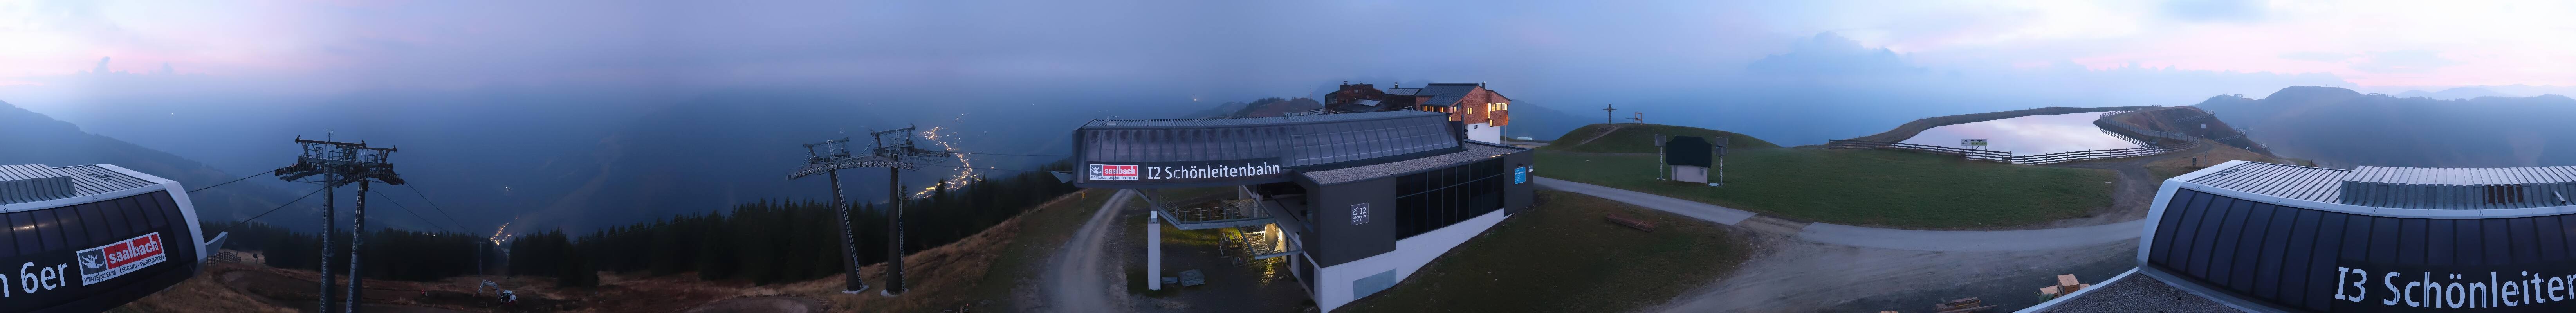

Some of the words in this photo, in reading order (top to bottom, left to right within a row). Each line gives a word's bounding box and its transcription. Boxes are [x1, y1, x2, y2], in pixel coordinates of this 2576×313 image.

[1104, 166, 1135, 174] saalbach
[1148, 167, 1161, 179] I2
[1165, 162, 1280, 179] Schönleitenbahn
[108, 235, 159, 264] saalbach
[21, 262, 67, 293] 6er
[120, 263, 137, 273] LEOGANG
[2335, 267, 2367, 302] I3
